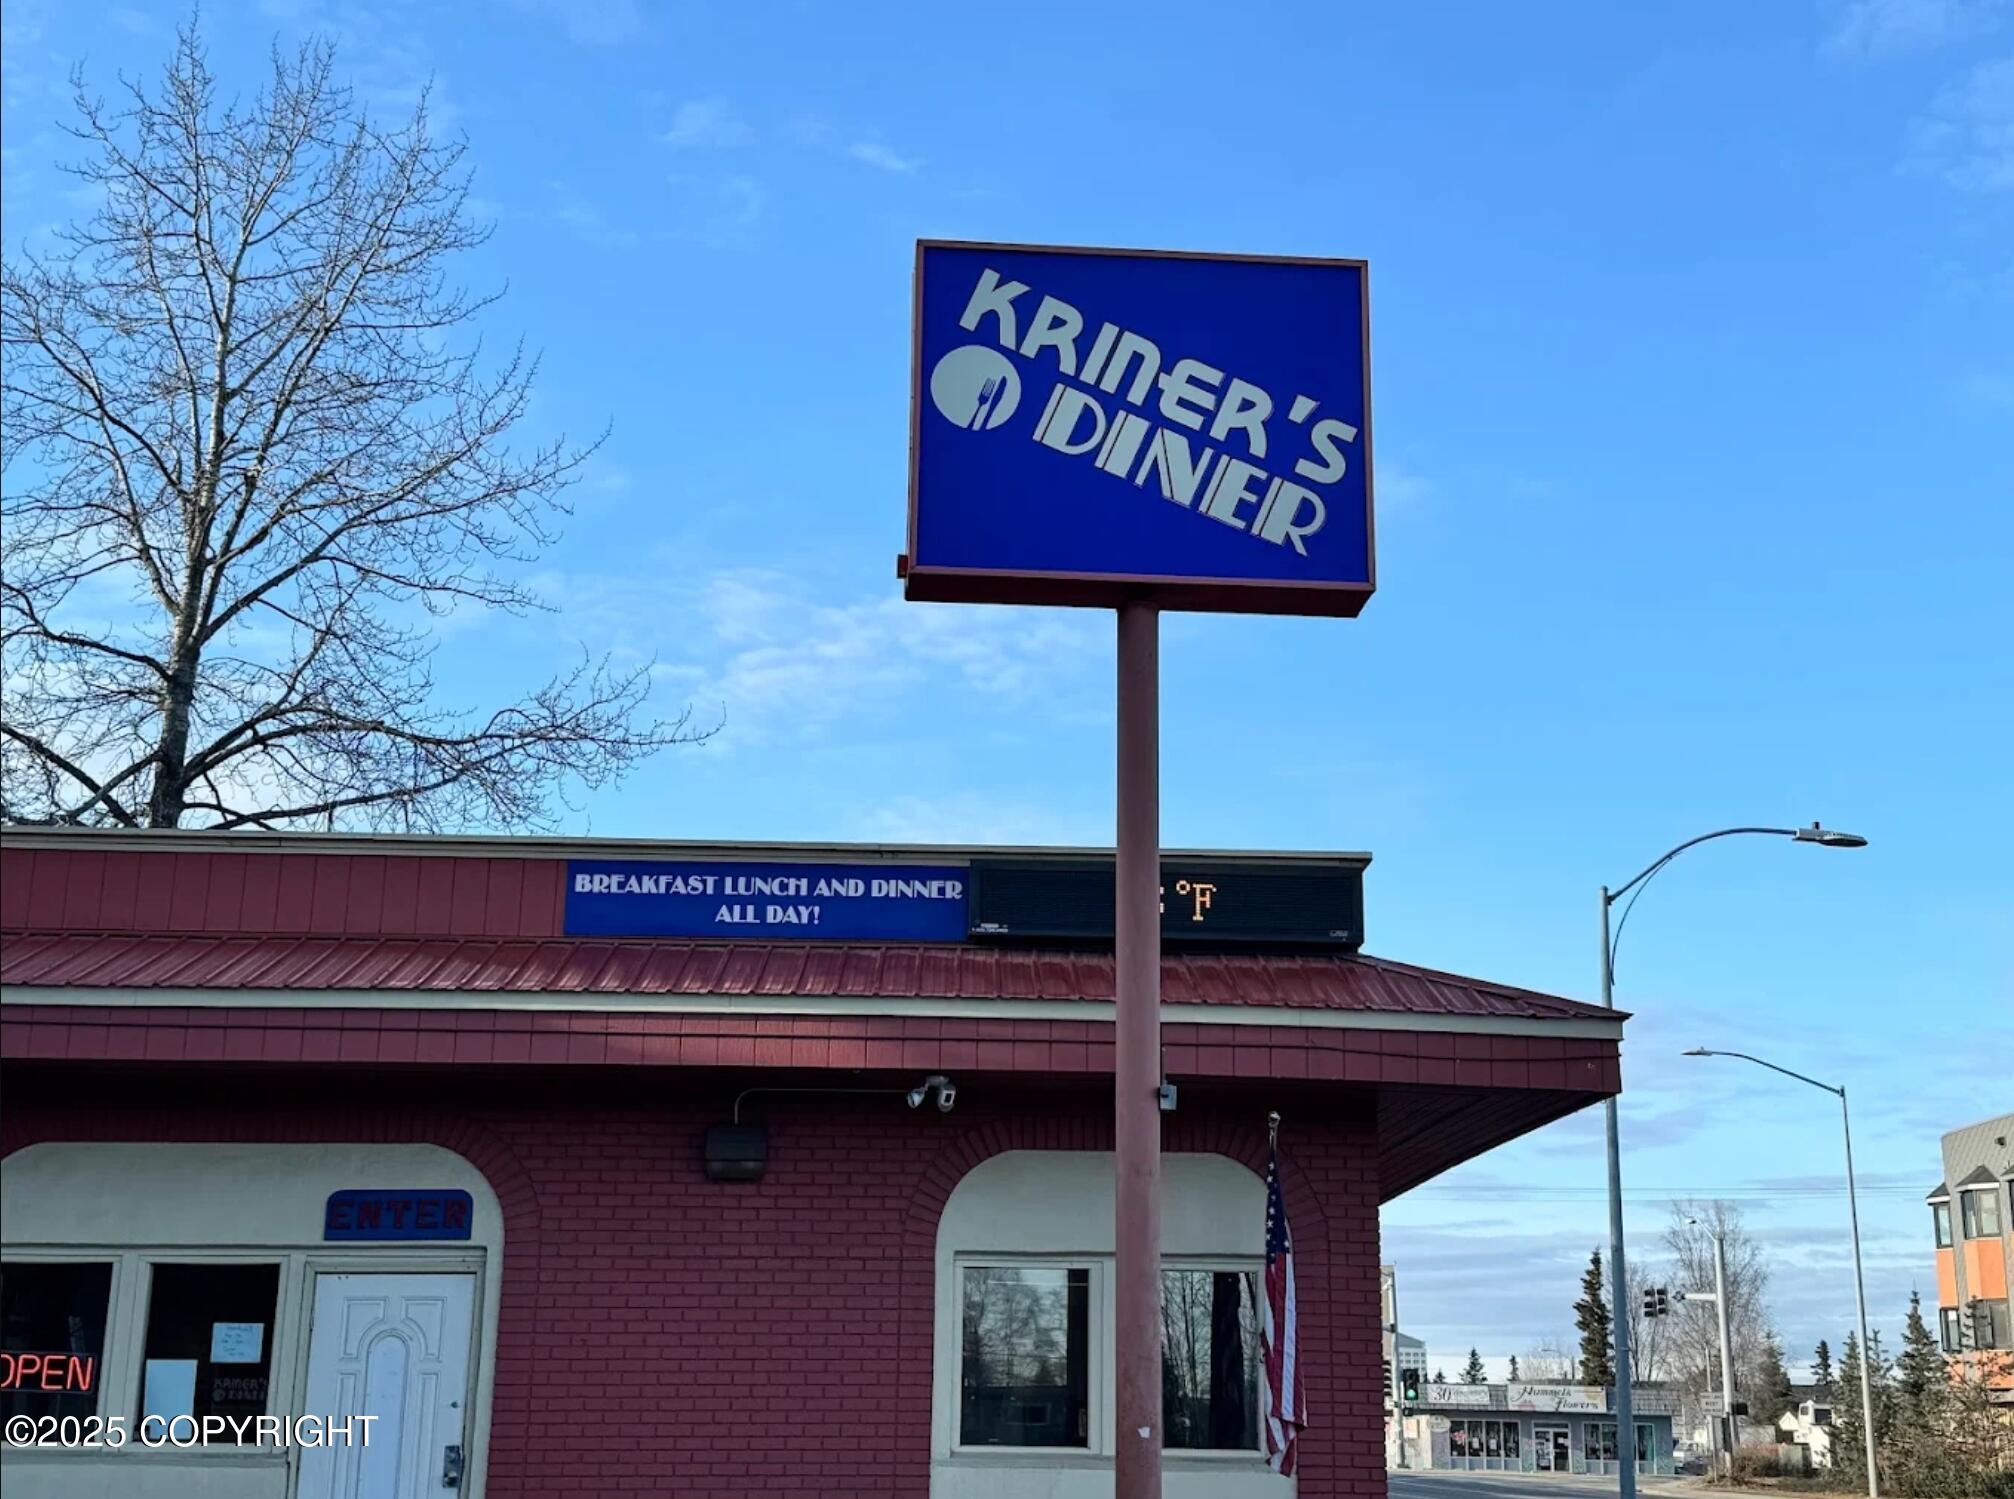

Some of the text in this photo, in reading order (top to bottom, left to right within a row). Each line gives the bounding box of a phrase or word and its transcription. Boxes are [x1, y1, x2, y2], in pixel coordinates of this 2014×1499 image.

[959, 268, 1358, 484] KRINER'S
[1033, 383, 1327, 557] DINER
[574, 873, 963, 900] BREAKFAST LUNCH AND DINNER
[715, 904, 820, 925] ALL DAY!
[329, 1199, 468, 1230] ENTER
